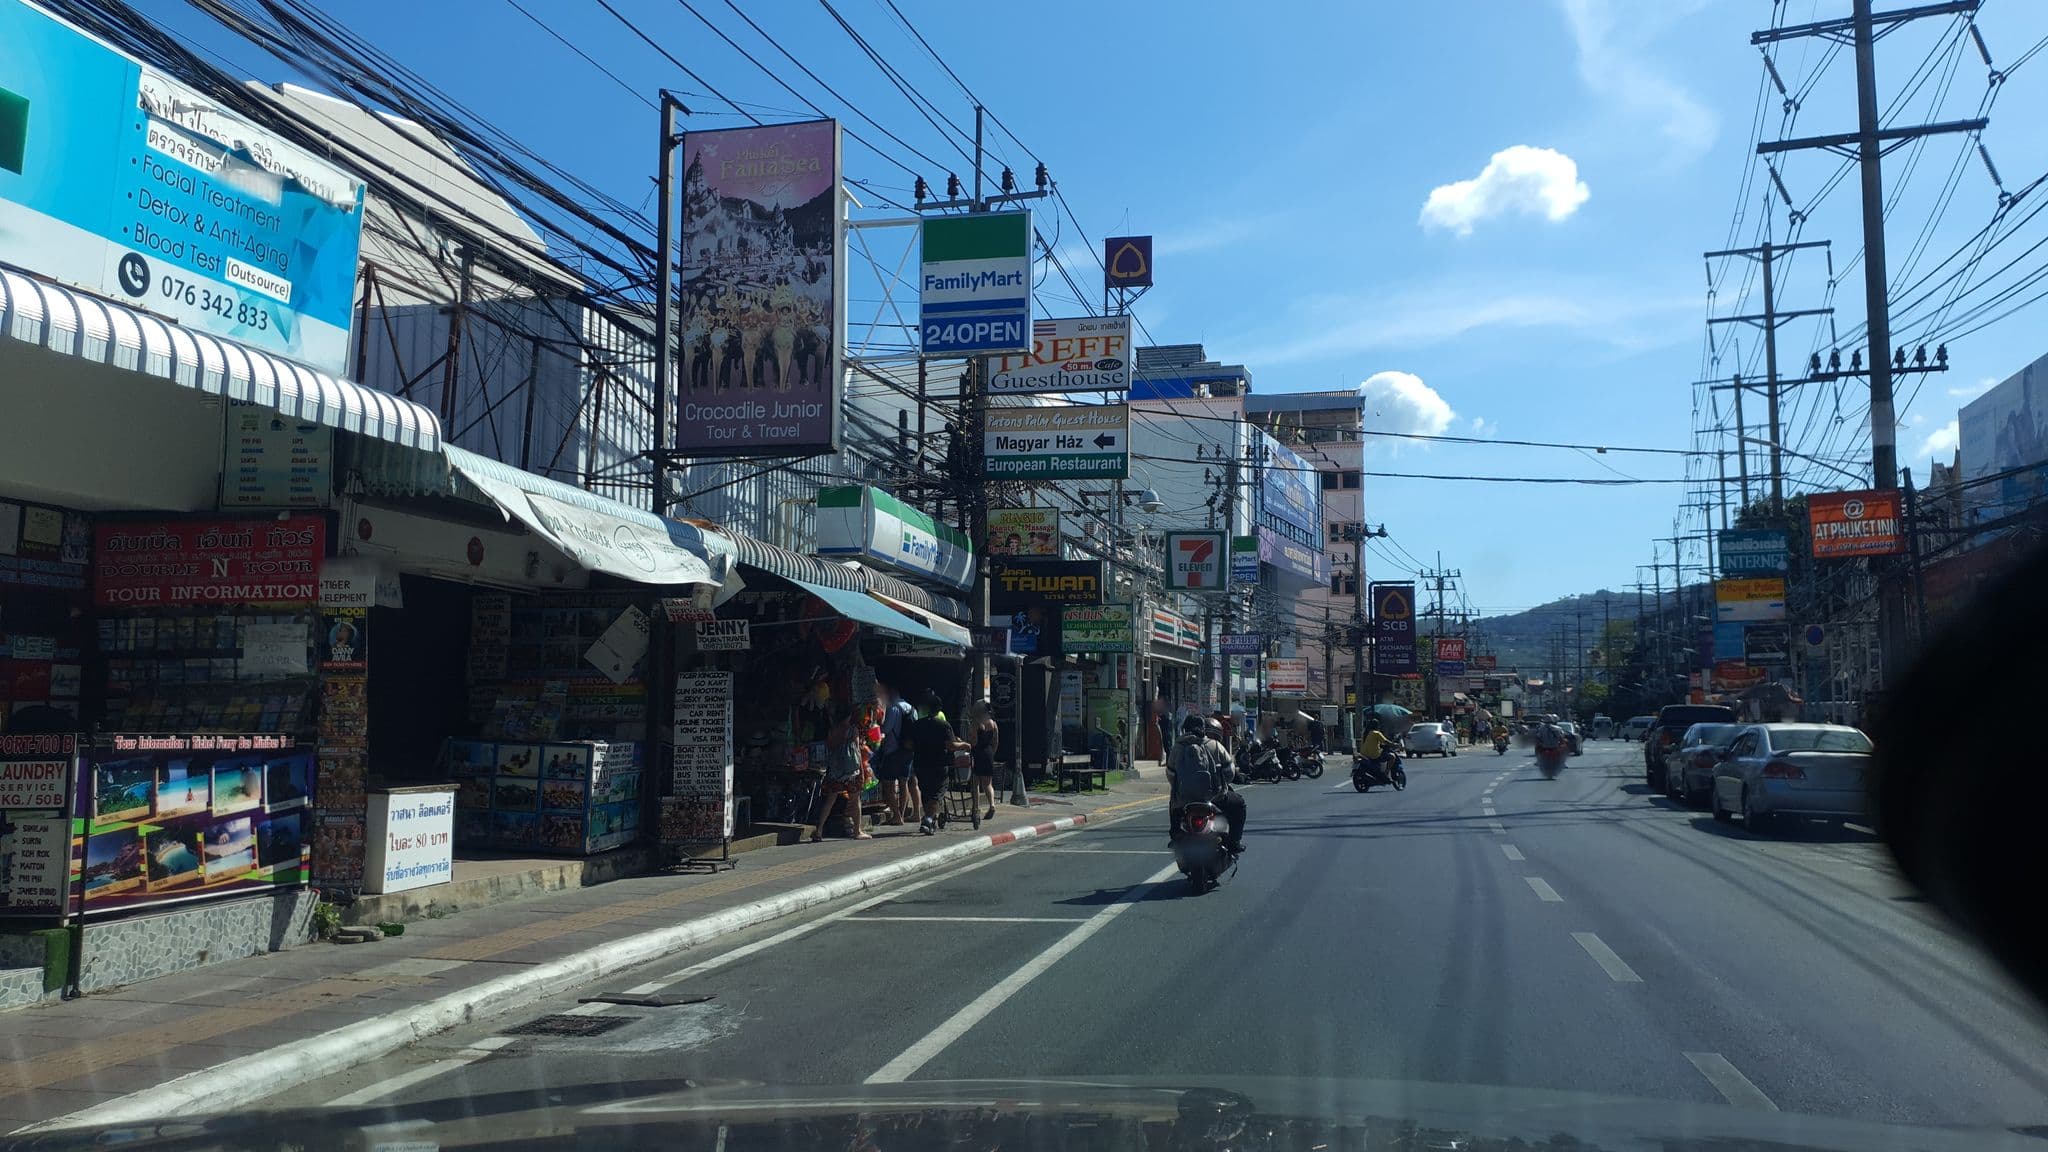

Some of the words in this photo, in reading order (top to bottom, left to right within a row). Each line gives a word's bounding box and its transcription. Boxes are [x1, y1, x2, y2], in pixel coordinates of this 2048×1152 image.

[143, 155, 196, 195] Facial
[201, 180, 281, 232] Treatment
[138, 191, 188, 228] Detox
[194, 214, 205, 234] &
[209, 221, 288, 271] Anti-Aging
[134, 225, 184, 260] Blood
[190, 243, 222, 272] Test
[226, 260, 291, 302] (Outsource)
[925, 270, 1022, 292] FamilyMart
[162, 276, 195, 306] 076
[200, 286, 233, 320] 342
[237, 300, 268, 330] 833
[1067, 363, 1078, 371] 50
[991, 369, 1124, 390] Guesthouse
[685, 401, 766, 421] Crocodile
[771, 400, 824, 419] Junior
[988, 415, 1023, 428] Patong
[1052, 413, 1085, 430] Guest
[1088, 410, 1122, 425] House
[706, 424, 737, 440] Tour
[742, 424, 752, 439] &
[759, 423, 800, 438] Travel
[996, 436, 1050, 452] Magyar
[1056, 434, 1084, 449] Ház
[986, 457, 1046, 474] European
[1051, 456, 1122, 471] Restaurant
[1815, 523, 1828, 540] AT
[1830, 519, 1876, 539] PHUKET
[1877, 518, 1900, 536] INN
[103, 564, 200, 577] DOUBLE
[211, 557, 229, 578] N
[246, 560, 313, 574] TOUR
[1179, 540, 1213, 587] 7
[106, 587, 161, 602] TOUR
[170, 584, 314, 600] INFORMATION
[324, 593, 368, 602] ELEPHENT
[340, 607, 367, 617] MOON
[697, 621, 746, 636] JENNY
[1381, 621, 1408, 631] SCB
[138, 735, 185, 749] Information
[0, 764, 65, 780] AUNDRY
[0, 783, 55, 791] SERVICE
[1, 795, 24, 805] KG.
[36, 794, 51, 805] 50
[391, 808, 416, 822] วาสนา
[389, 832, 412, 851] ใบละ
[416, 833, 427, 848] 80
[431, 832, 448, 846] บาท
[21, 850, 35, 858] KOH
[17, 888, 38, 896] JAMES
